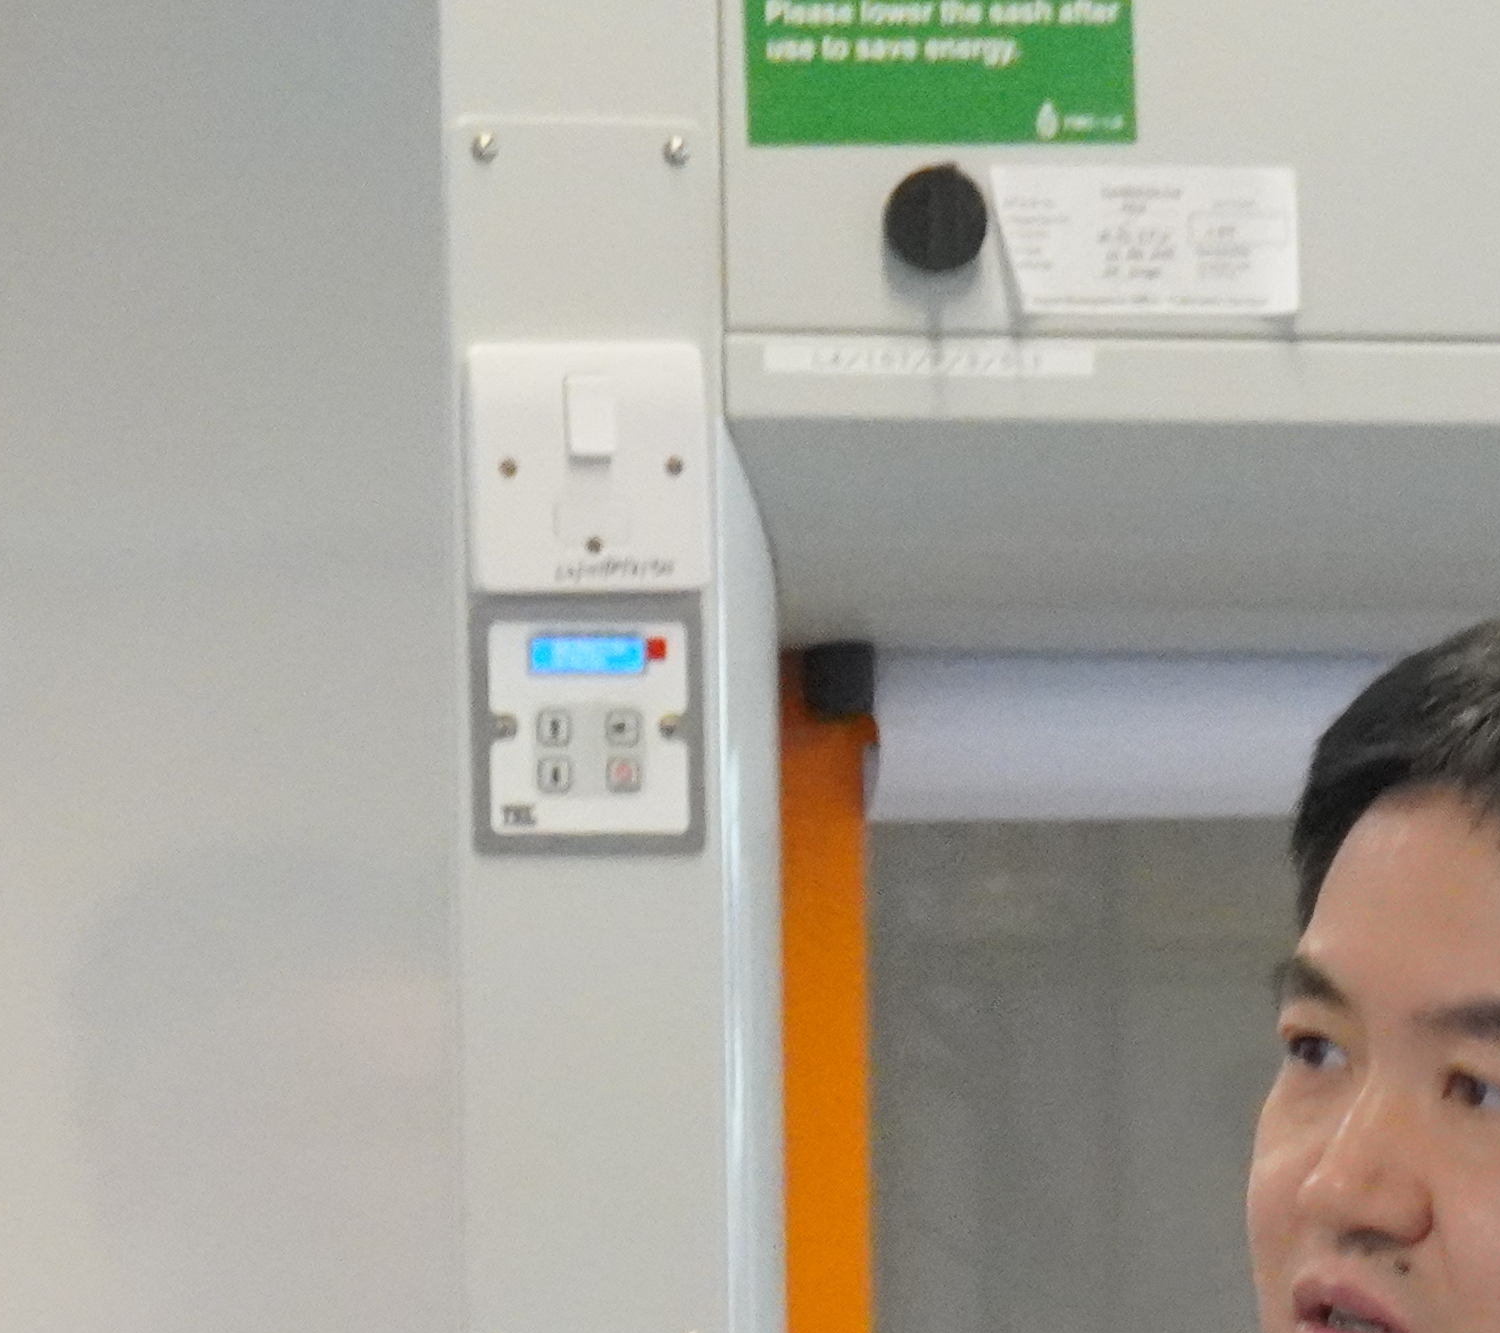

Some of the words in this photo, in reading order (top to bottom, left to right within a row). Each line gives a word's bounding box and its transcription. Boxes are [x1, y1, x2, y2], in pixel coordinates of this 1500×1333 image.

[766, 0, 854, 26] Please
[860, 0, 932, 26] lower
[940, 0, 982, 26] the
[989, 0, 1054, 26] sash
[1058, 0, 1122, 26] after
[766, 39, 815, 62] use
[822, 35, 850, 62] to
[855, 39, 918, 62] save
[924, 38, 1022, 68] energy.
